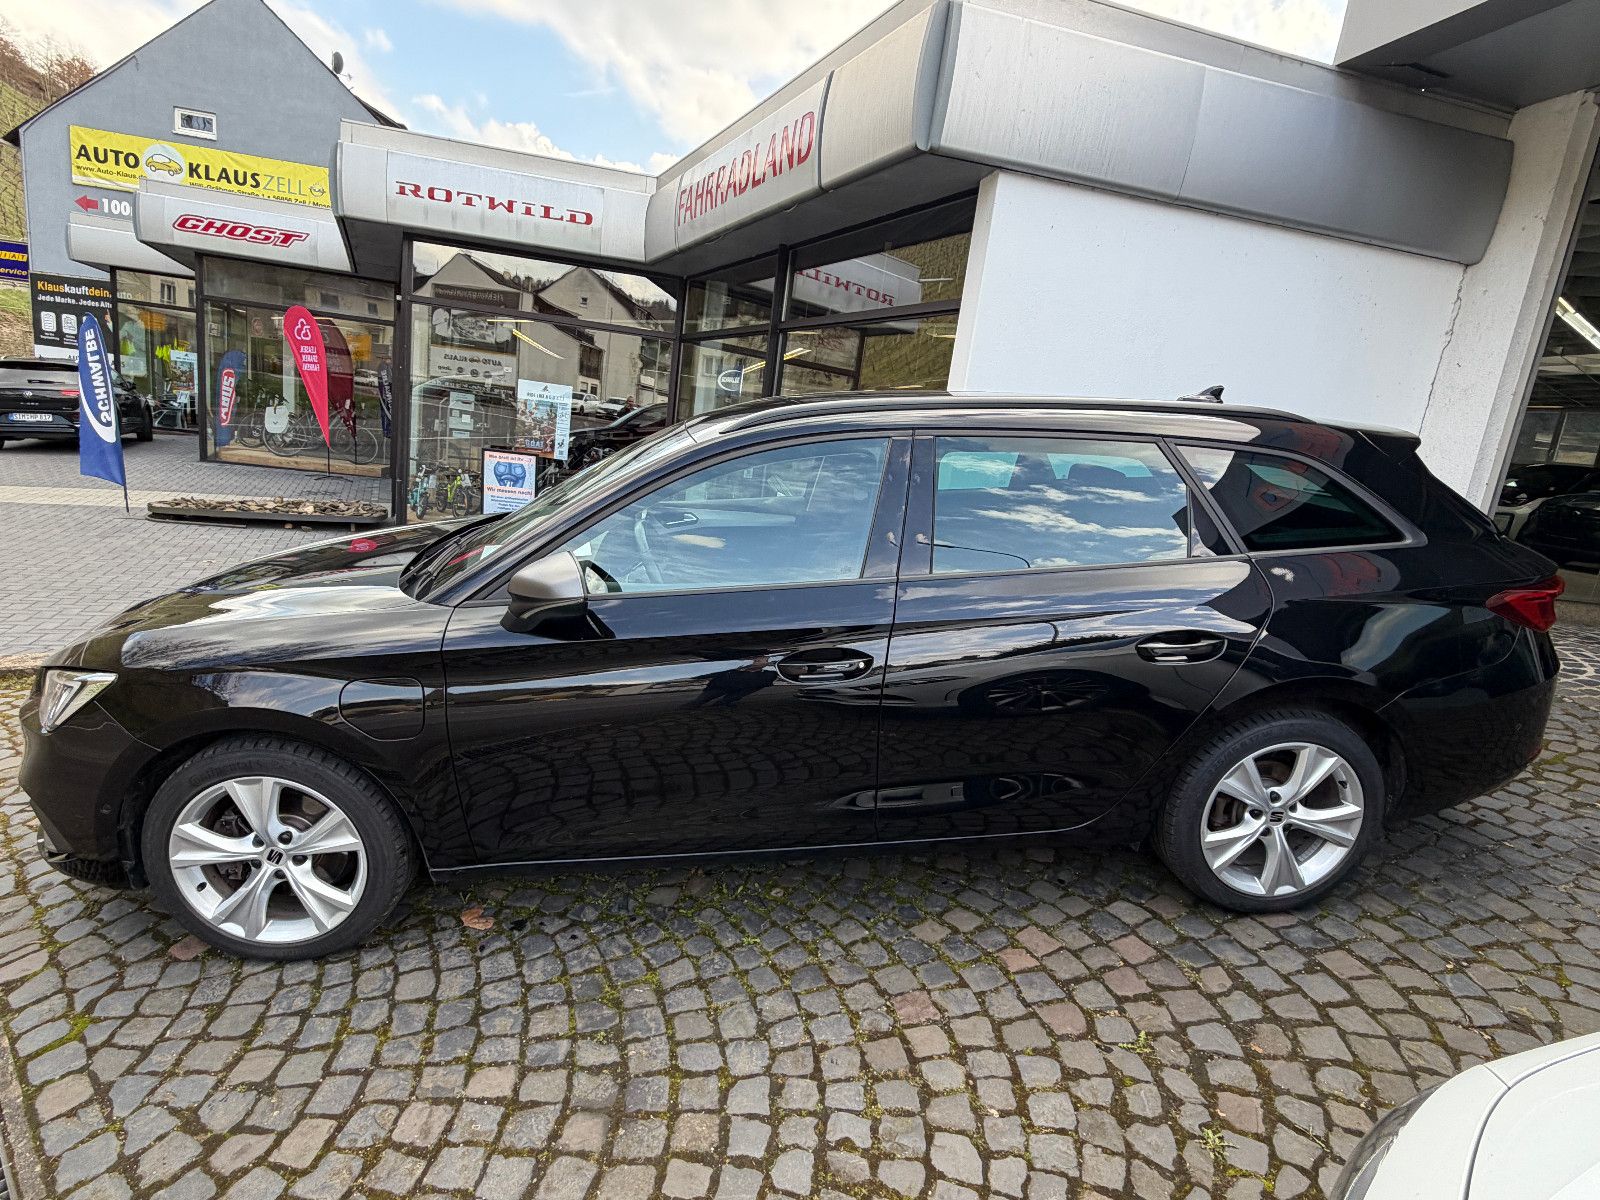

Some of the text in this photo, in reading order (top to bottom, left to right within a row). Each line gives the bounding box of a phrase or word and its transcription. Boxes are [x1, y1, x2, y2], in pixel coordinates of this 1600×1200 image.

[76, 144, 140, 169] AUTO
[678, 111, 815, 226] FAHRRADLAND
[101, 198, 133, 216] 100
[395, 180, 594, 226] ROTWILD
[174, 214, 309, 248] GHOST
[85, 328, 112, 424] SCHWALBE
